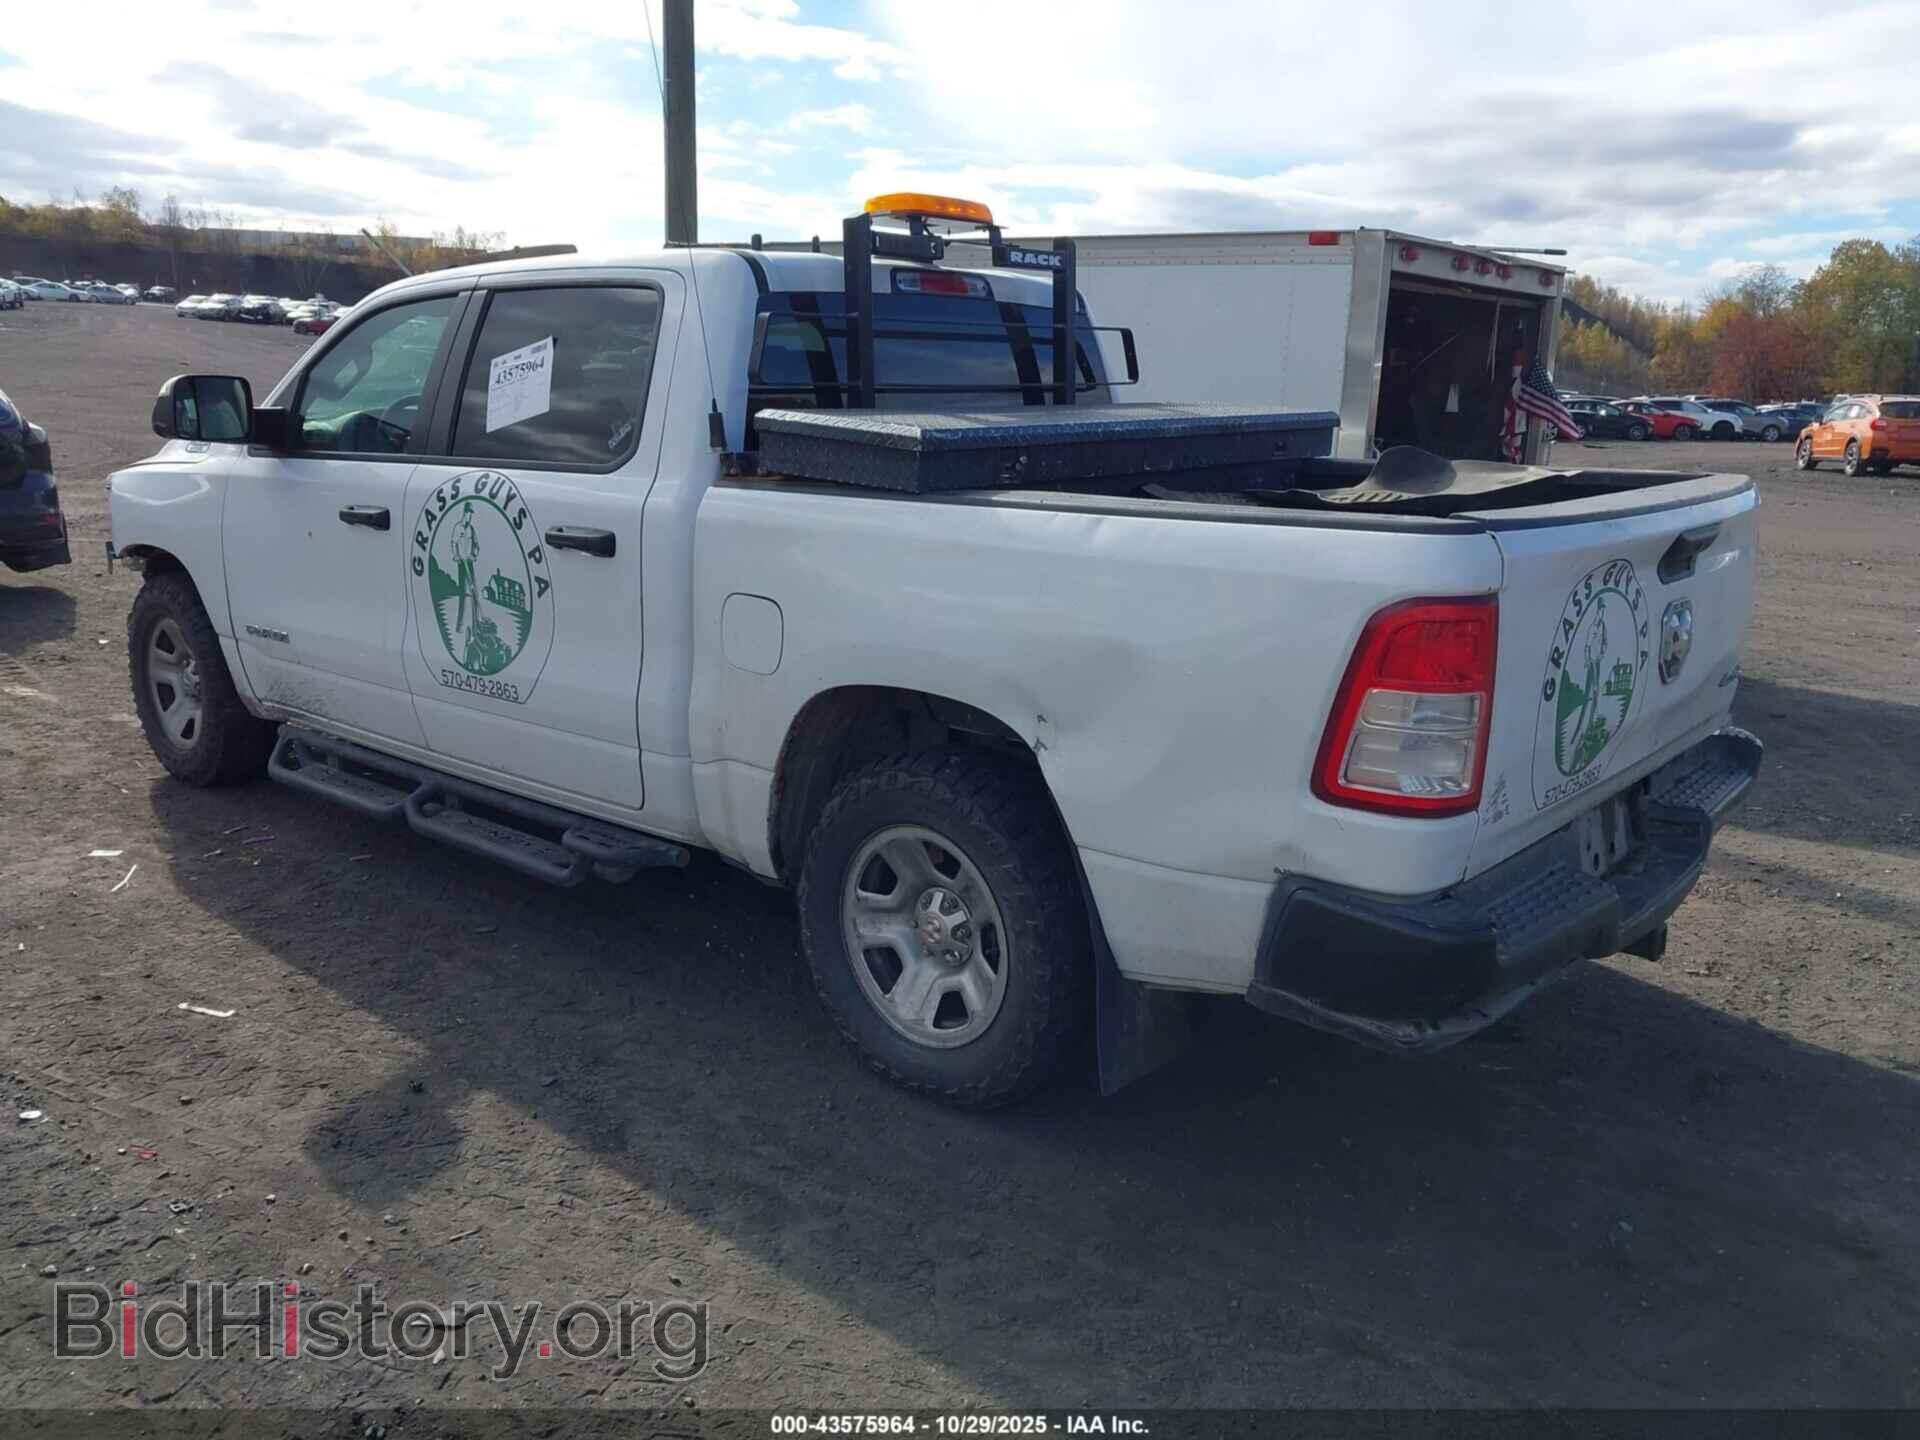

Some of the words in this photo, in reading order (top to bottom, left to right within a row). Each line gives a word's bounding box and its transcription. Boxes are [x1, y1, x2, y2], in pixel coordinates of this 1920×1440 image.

[1010, 251, 1062, 267] RACK
[412, 477, 463, 577] GRASS
[474, 472, 528, 531] GUYS
[1543, 575, 1593, 702] GRASS
[1602, 562, 1641, 612] GUYS
[441, 668, 520, 701] 570-479-2863
